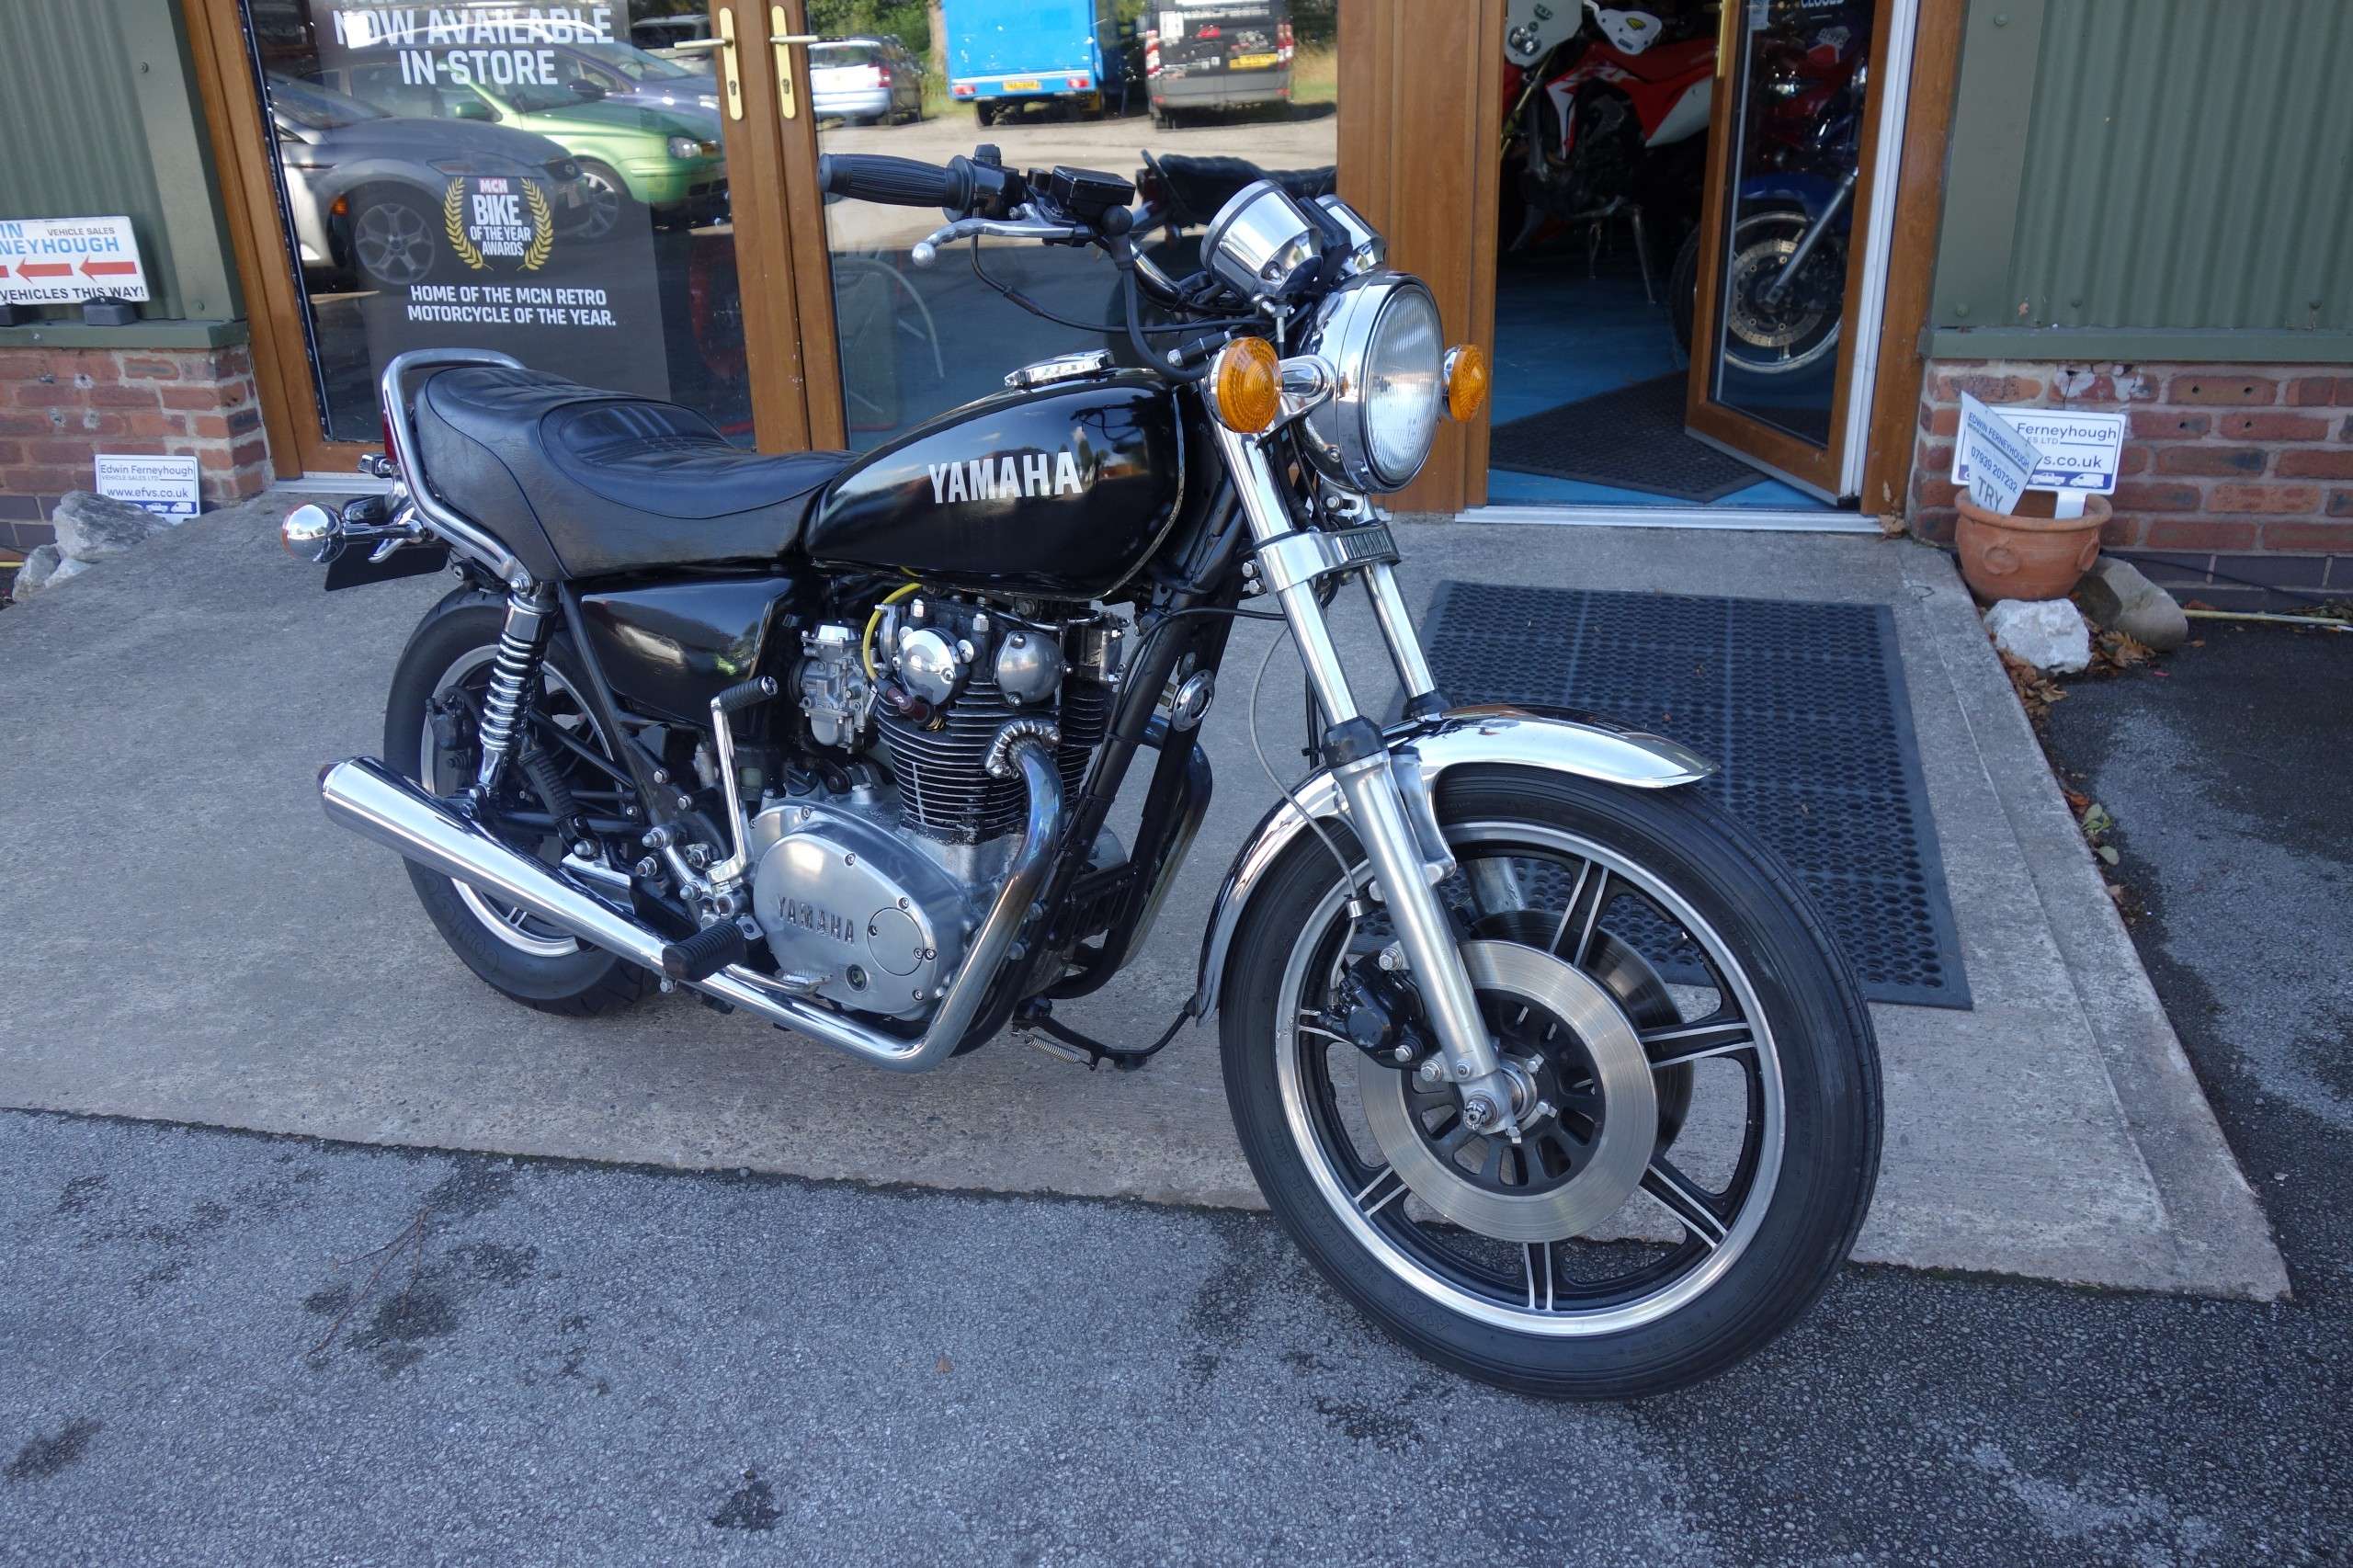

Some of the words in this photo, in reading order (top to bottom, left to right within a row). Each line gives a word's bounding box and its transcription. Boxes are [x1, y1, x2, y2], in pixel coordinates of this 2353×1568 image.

[333, 9, 415, 44] NOW
[427, 8, 614, 44] AVAILABLE
[399, 50, 558, 85] IN-STORE
[479, 178, 508, 194] MCN
[472, 195, 523, 226] BIKE
[47, 228, 84, 236] VEHICLE
[86, 227, 115, 235] SALES
[470, 226, 483, 240] OF
[483, 226, 504, 241] THE
[503, 226, 532, 241] YEAR
[483, 241, 525, 256] AWARDS
[0, 287, 68, 301] VEHICLES
[73, 287, 106, 299] THIS
[108, 286, 145, 299] WAY!
[410, 285, 457, 301] HOME
[460, 286, 479, 302] OF
[482, 287, 513, 303] THE
[516, 288, 552, 304] MCN
[556, 289, 607, 305] RETRO
[407, 305, 511, 323] MOTORCYCLE
[514, 307, 533, 324] OF
[537, 308, 567, 324] THE
[569, 309, 616, 325] YEAR.
[1969, 412, 1987, 433] EDWIN
[1988, 427, 2029, 470] FERNEYHOUGH
[2017, 423, 2116, 441] Ferneyhough
[100, 464, 129, 473] Edwin
[131, 465, 193, 476] Ferneyhough
[928, 451, 1083, 504] YAMAHA
[1971, 446, 1993, 471] 07939
[1992, 464, 2018, 494] 207232
[107, 487, 188, 497] www.efvs.co.uk
[1978, 475, 2003, 512] TRY
[777, 894, 855, 947] YAMAHA
